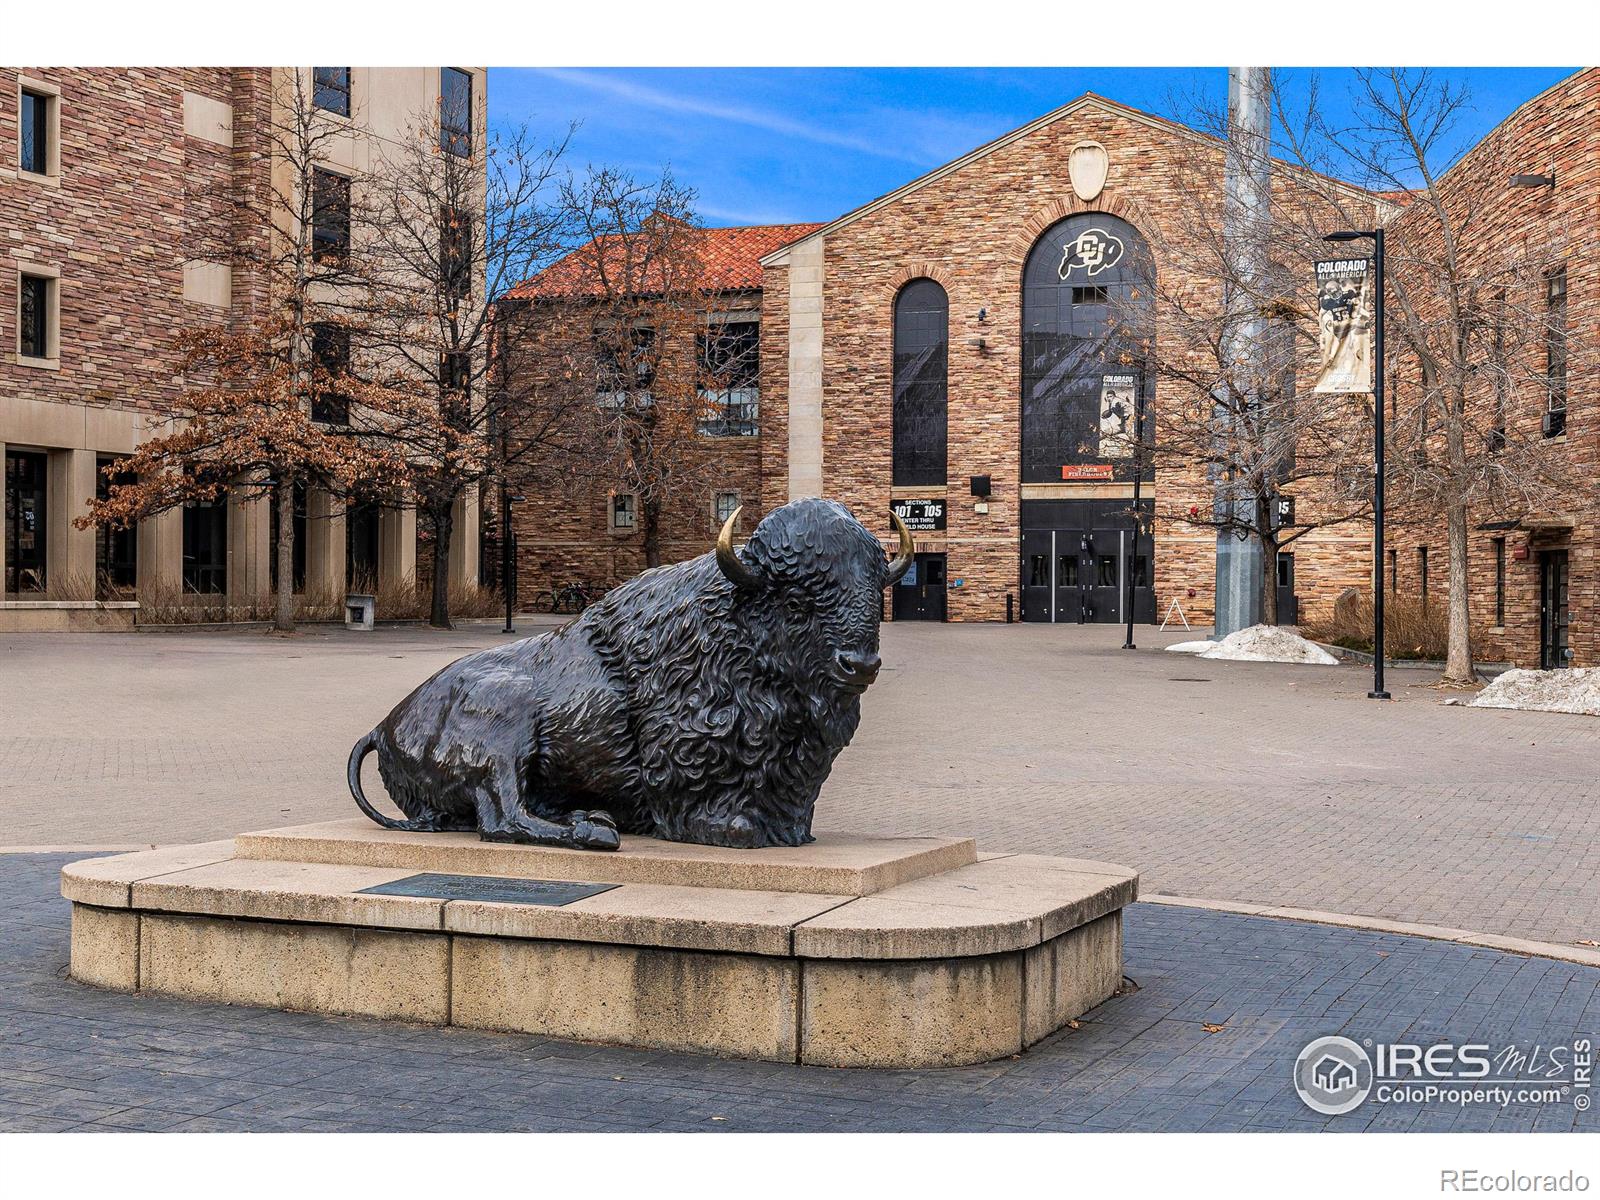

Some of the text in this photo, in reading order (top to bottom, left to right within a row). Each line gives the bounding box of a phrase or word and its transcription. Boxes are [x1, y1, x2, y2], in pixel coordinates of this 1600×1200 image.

[1317, 260, 1367, 273] COLORADO
[895, 505, 911, 518] 101
[924, 505, 942, 517] 105
